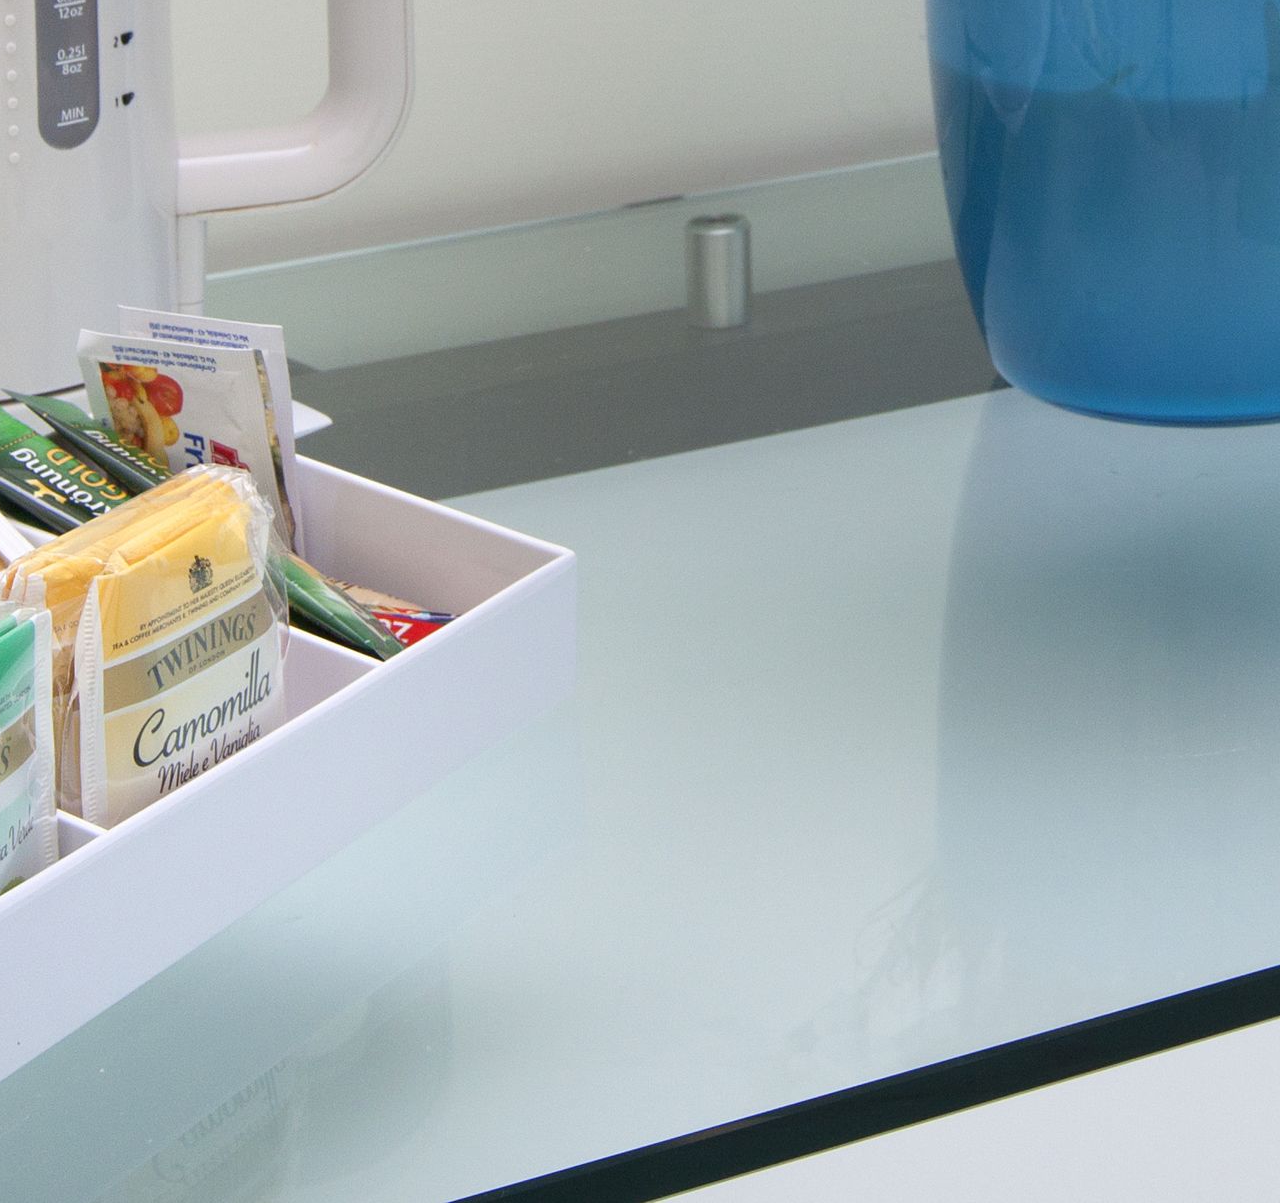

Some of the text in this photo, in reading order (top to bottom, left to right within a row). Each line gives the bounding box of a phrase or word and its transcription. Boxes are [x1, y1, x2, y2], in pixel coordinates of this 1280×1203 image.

[58, 6, 84, 19] 12oz
[62, 61, 83, 74] 8oz
[61, 107, 85, 121] MIN
[184, 431, 206, 468] Fr
[46, 447, 128, 501] GOLD
[112, 642, 124, 651] TEA
[129, 630, 151, 644] COFFEE
[147, 613, 256, 692] TWININGS
[188, 650, 226, 674] OF LONDON
[133, 647, 272, 767] Camomilla
[158, 750, 199, 794] Miele
[202, 757, 210, 772] e
